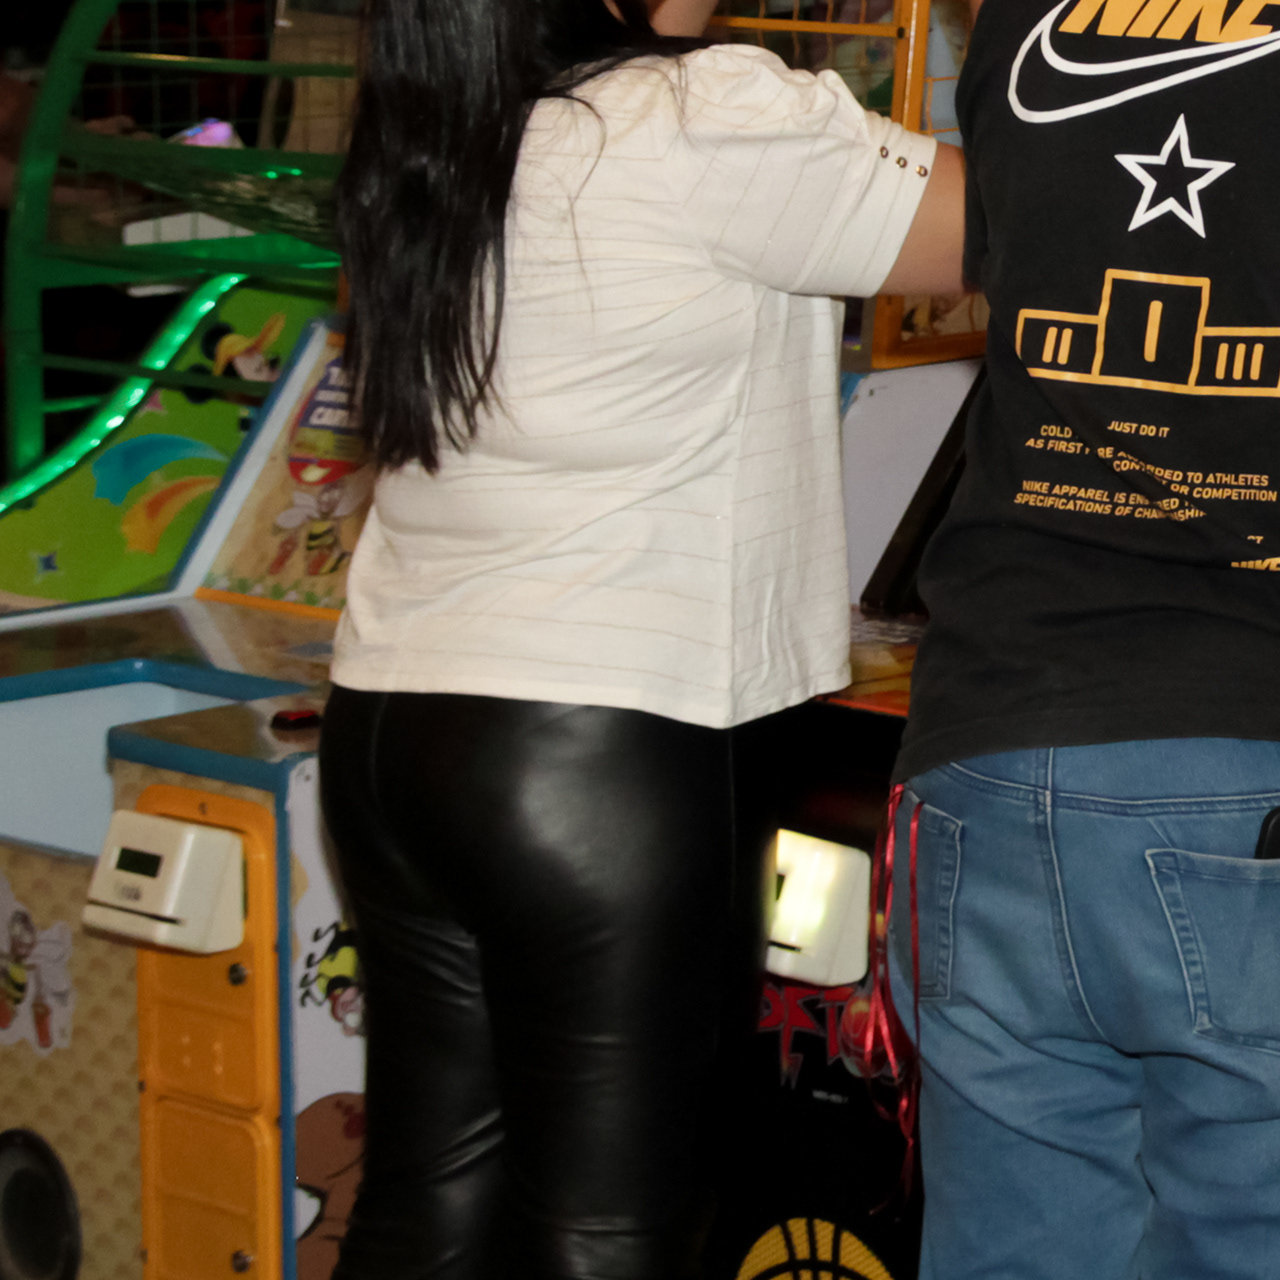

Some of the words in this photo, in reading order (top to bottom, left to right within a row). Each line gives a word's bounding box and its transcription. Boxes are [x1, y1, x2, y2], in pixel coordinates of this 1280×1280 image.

[1107, 421, 1138, 434] JUST
[1139, 425, 1156, 437] DO
[1158, 427, 1170, 438] IT
[1025, 438, 1045, 449] AS
[1047, 440, 1084, 454] FIRST
[1186, 472, 1203, 484] TO
[1206, 473, 1269, 487] ATHLETES
[1022, 480, 1050, 494] NIKE
[1052, 484, 1110, 502] APPAREL
[1113, 492, 1127, 504] IS
[1170, 483, 1190, 495] OR
[1193, 487, 1278, 502] COMPETITION
[1014, 492, 1113, 514] SPECIFICATIONS
[1114, 506, 1133, 517] OF
